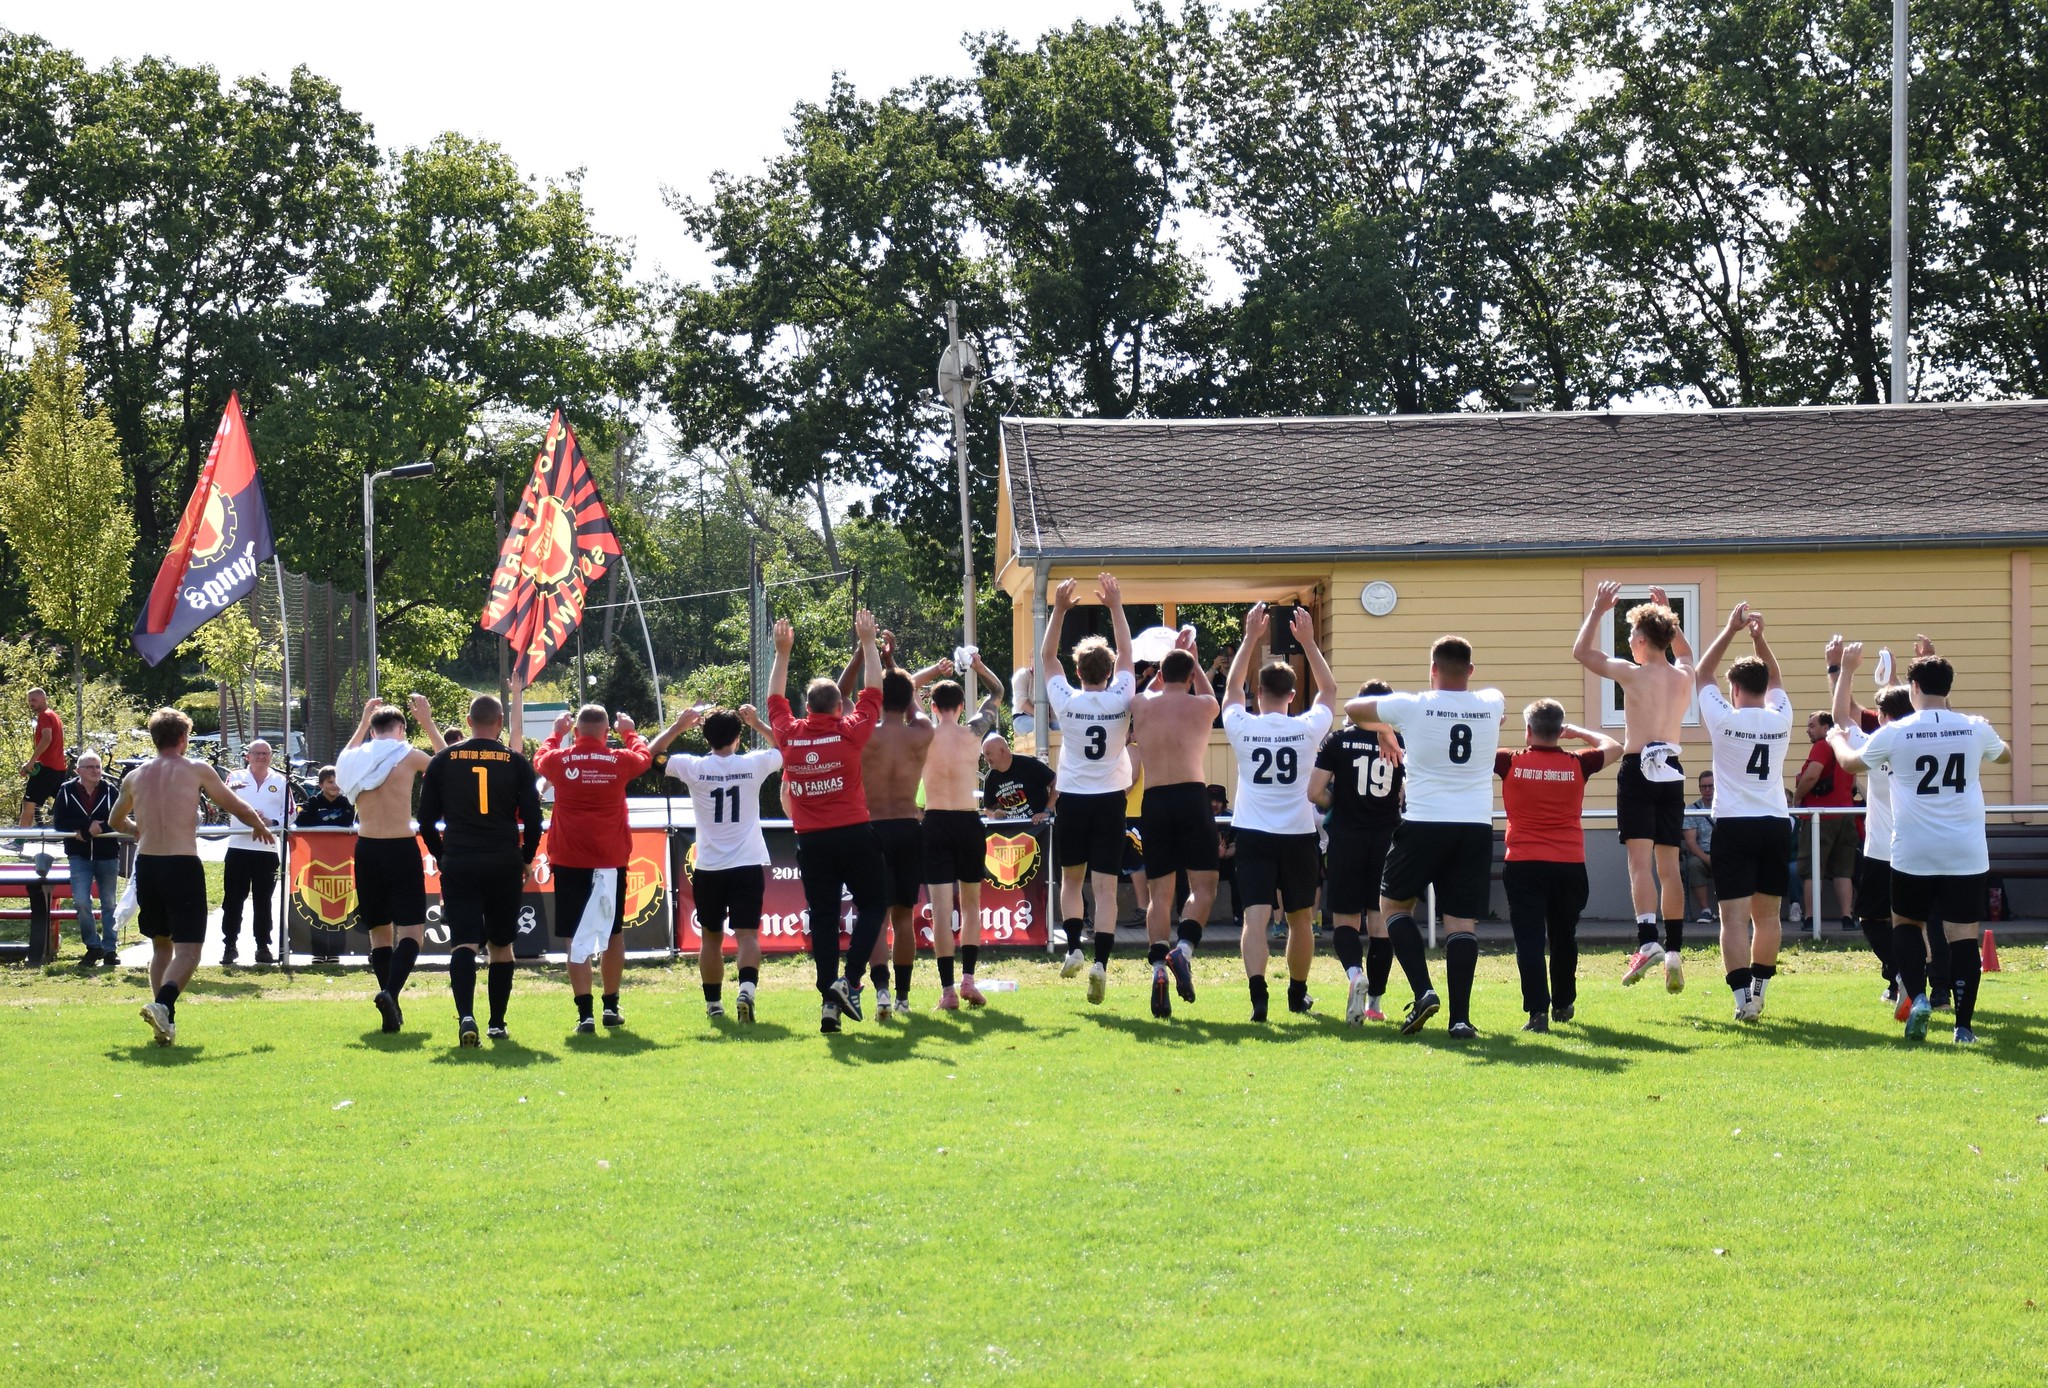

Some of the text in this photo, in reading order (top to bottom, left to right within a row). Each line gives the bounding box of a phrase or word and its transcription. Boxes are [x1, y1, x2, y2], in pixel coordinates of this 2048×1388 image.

[1097, 711, 1126, 720] SÖRNEWITZ
[1275, 734, 1305, 743] SÖRNEWITZ
[1735, 731, 1756, 739] MOTOR
[1760, 731, 1788, 740] SÖRNEWITZ
[1940, 729, 1972, 737] SÖRNEWITZ
[1084, 725, 1107, 760] 3
[1352, 742, 1373, 751] MOTOR
[1449, 723, 1472, 764] 8
[450, 749, 511, 762] SV MOTOR SÖRNEWITZ
[562, 755, 570, 764] SV
[1746, 743, 1770, 780] 4
[1252, 746, 1298, 785] 29
[1353, 755, 1394, 798] 19
[1514, 767, 1575, 781] SV MOTOR SÖRNEWITZ
[1915, 753, 1966, 795] 24
[471, 766, 489, 815] 1
[805, 776, 844, 791] FARKAS
[710, 785, 740, 823] 11
[772, 867, 802, 880] 201
[313, 875, 354, 899] MOTOR
